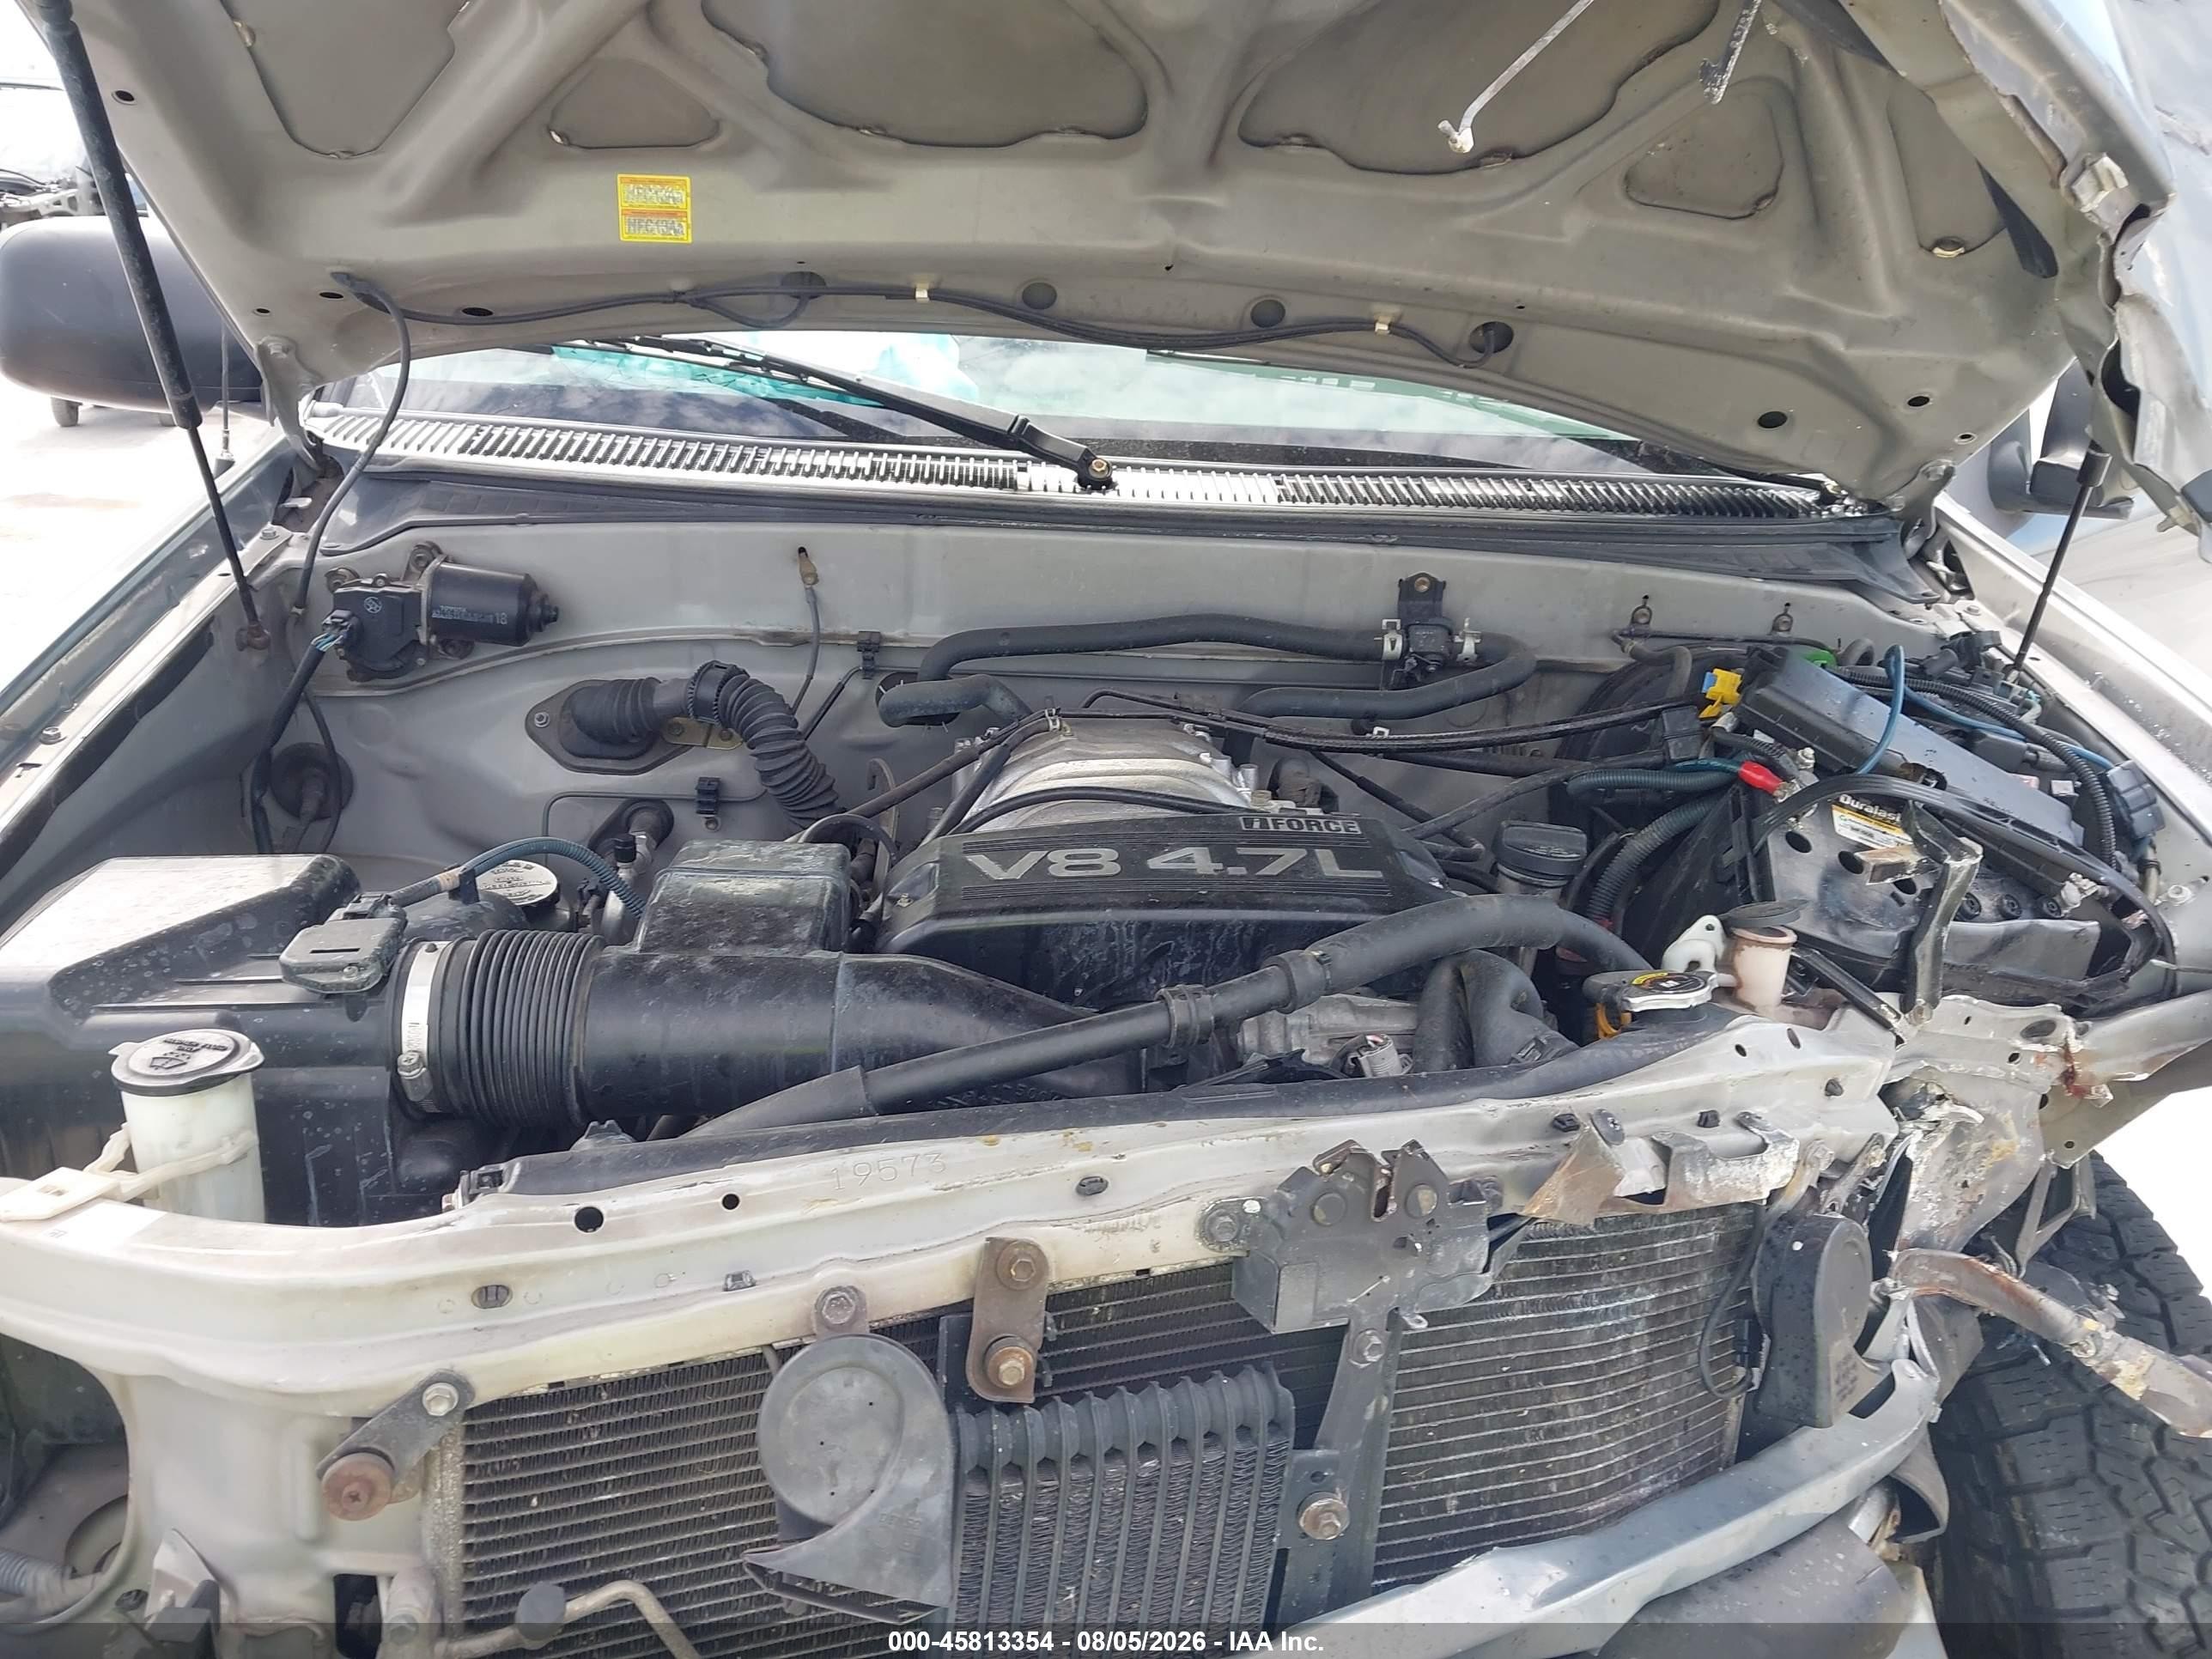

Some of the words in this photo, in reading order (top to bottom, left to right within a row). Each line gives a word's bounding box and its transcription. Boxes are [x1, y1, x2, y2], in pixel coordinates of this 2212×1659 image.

[1838, 793, 1902, 823] Duralast
[965, 847, 1121, 880] V8
[1146, 846, 1383, 878] 4.7L
[830, 1152, 946, 1191] 19573
